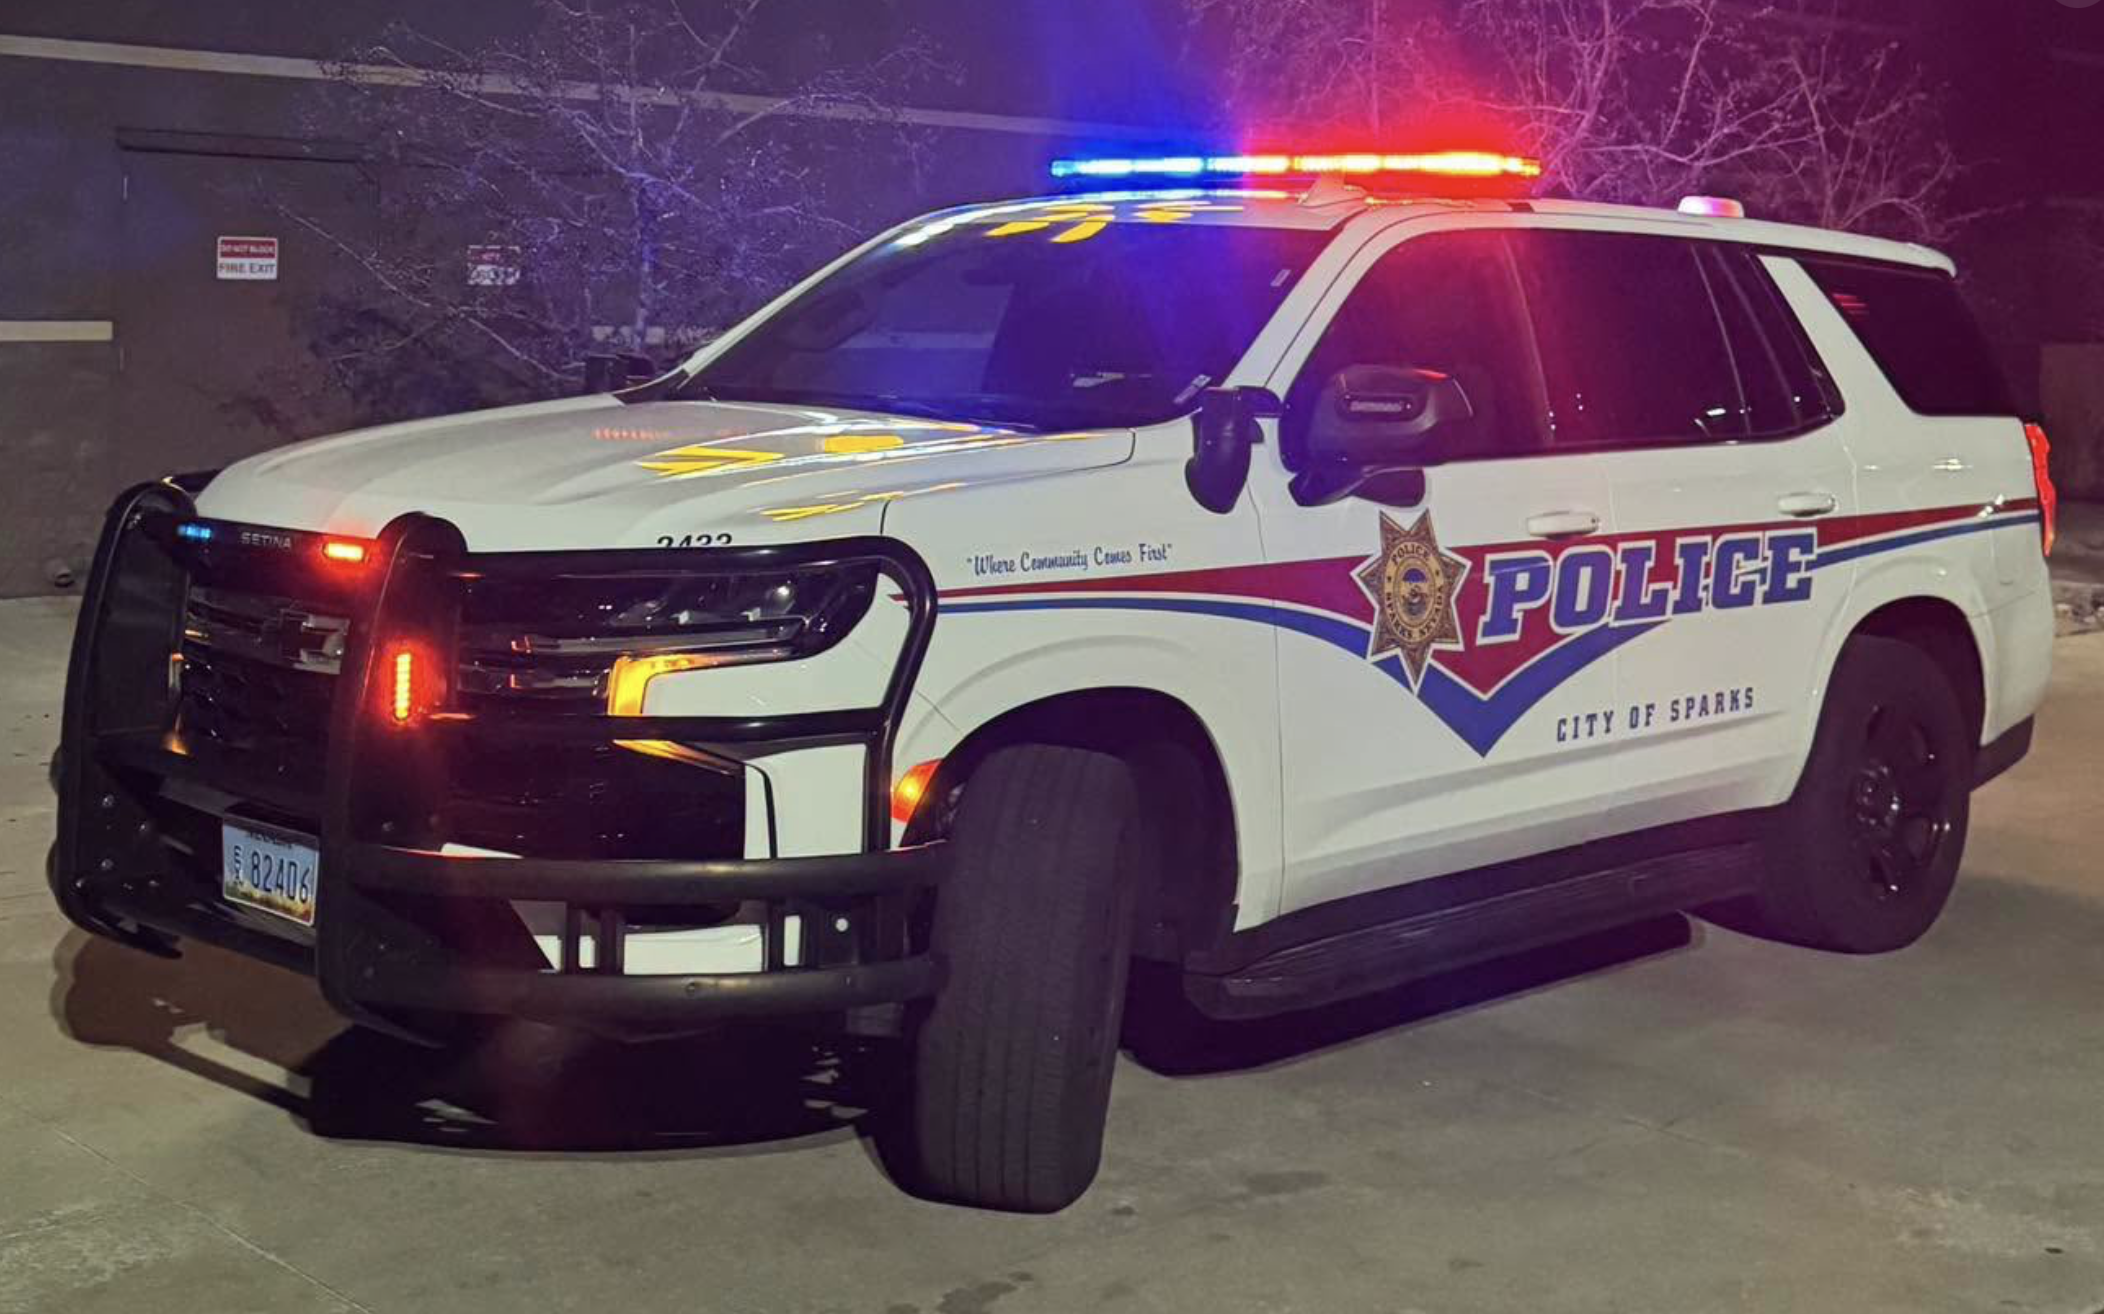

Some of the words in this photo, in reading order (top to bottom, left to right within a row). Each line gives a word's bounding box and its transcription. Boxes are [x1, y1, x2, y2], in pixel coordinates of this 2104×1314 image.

[219, 262, 247, 274] FIRE
[250, 262, 276, 274] EXIT
[241, 531, 291, 548] SETINA
[1020, 549, 1088, 572] Community
[1094, 546, 1132, 566] Comes
[1391, 543, 1430, 564] POLICE
[1476, 527, 1817, 645] POLICE
[1556, 710, 1615, 743] CITY
[1628, 702, 1656, 730] OF
[1669, 686, 1754, 722] SPARKS
[251, 850, 310, 903] 82406
